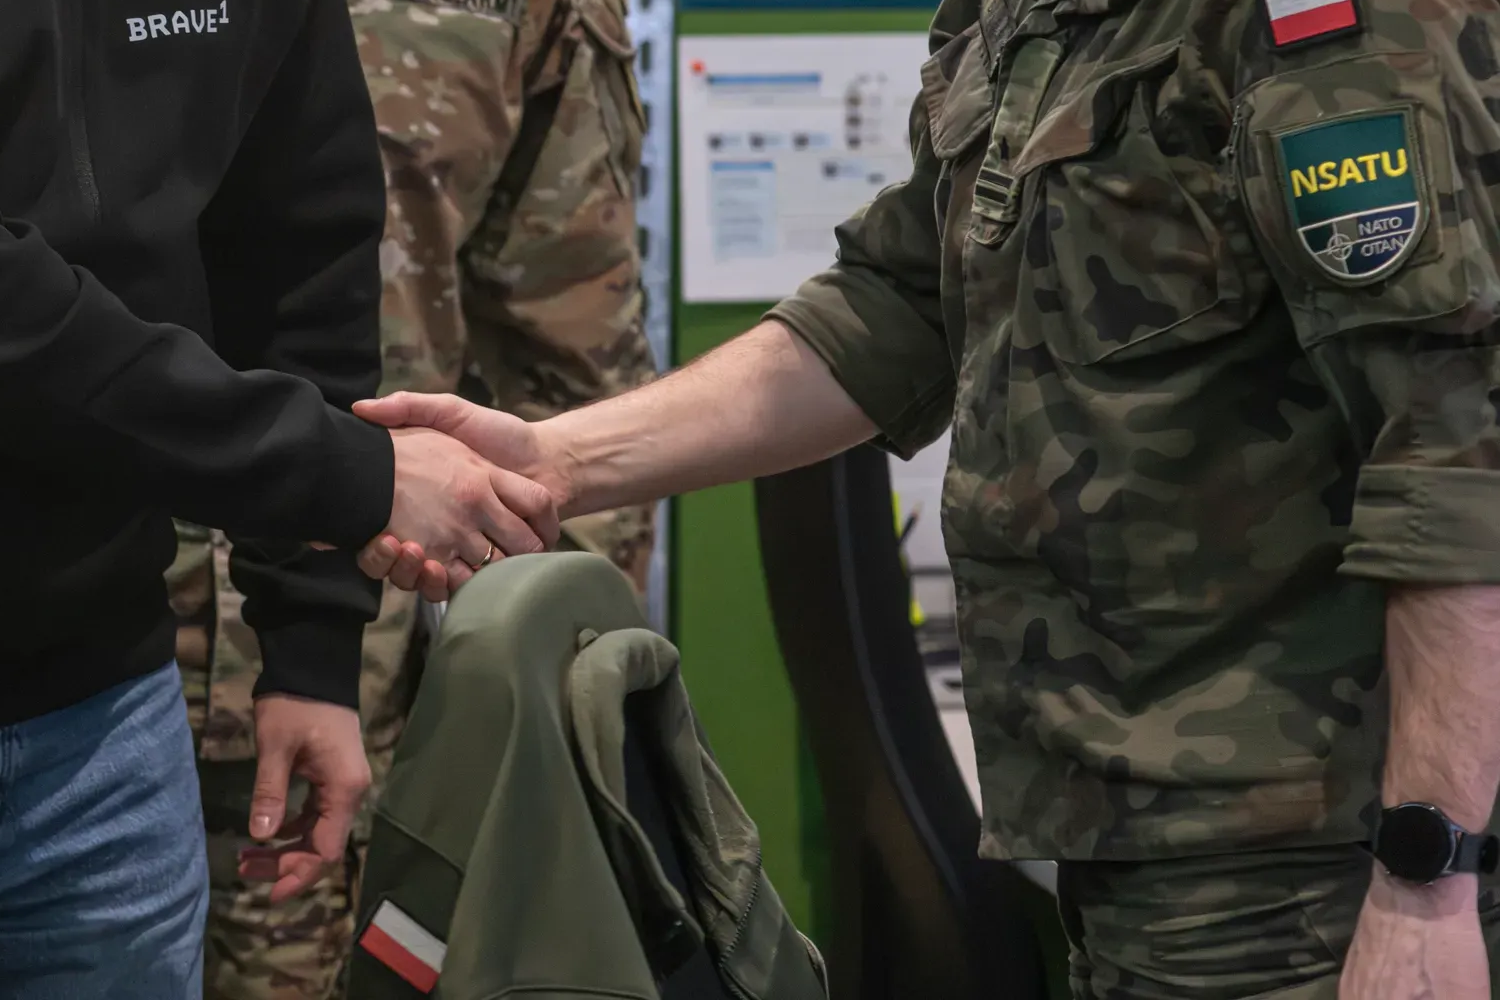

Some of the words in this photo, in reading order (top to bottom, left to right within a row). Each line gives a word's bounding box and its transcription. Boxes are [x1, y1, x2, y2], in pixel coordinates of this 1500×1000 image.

[1291, 149, 1408, 198] NSATU
[1358, 216, 1403, 236] NATO
[1361, 236, 1406, 258] OTAN
